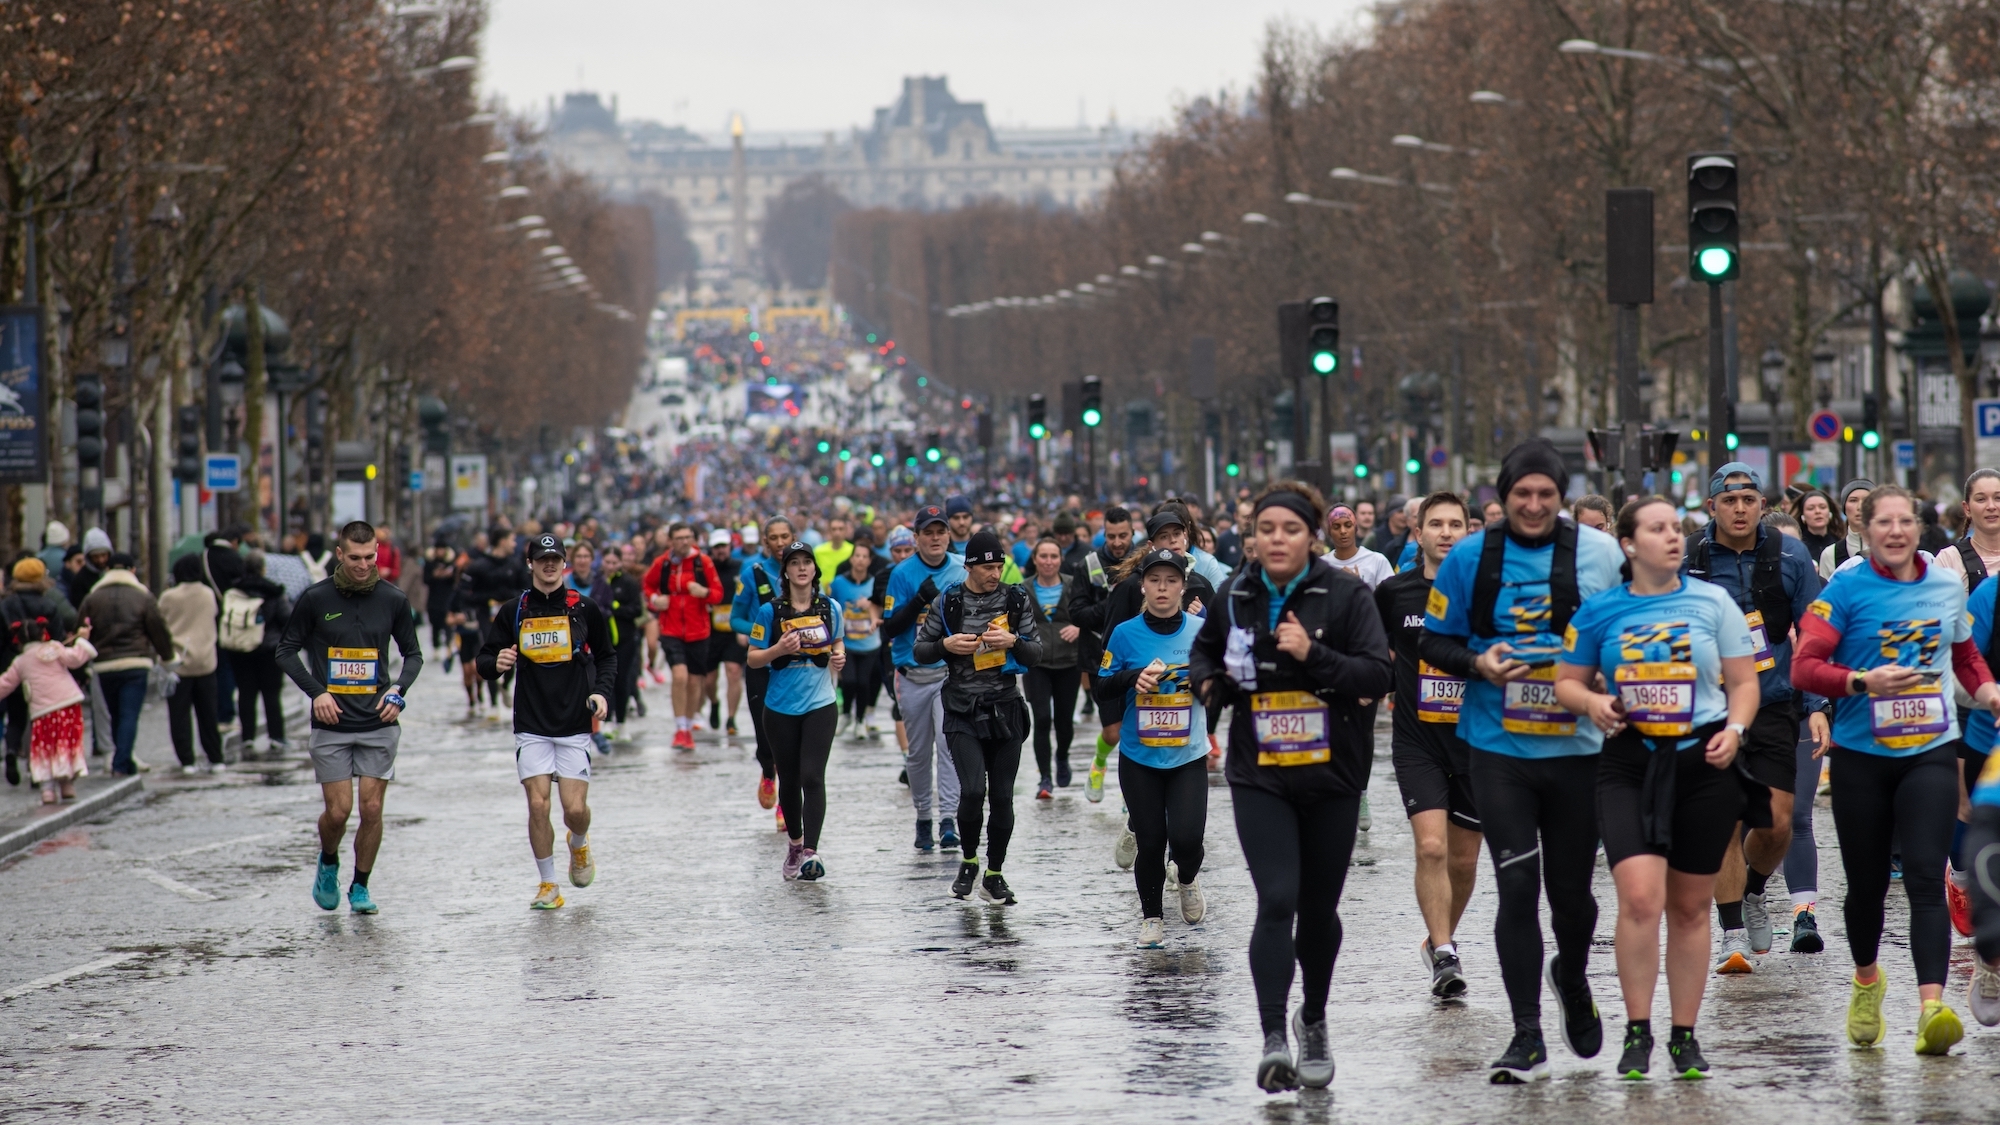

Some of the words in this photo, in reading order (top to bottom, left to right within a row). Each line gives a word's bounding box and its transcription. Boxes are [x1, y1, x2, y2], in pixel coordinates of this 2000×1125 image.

[1985, 406, 2000, 434] P
[530, 631, 559, 645] 19776
[339, 662, 367, 675] 11435
[1633, 686, 1679, 706] 19865
[1149, 711, 1179, 726] 13271
[1892, 699, 1927, 720] 6139
[1271, 714, 1306, 735] 8921
